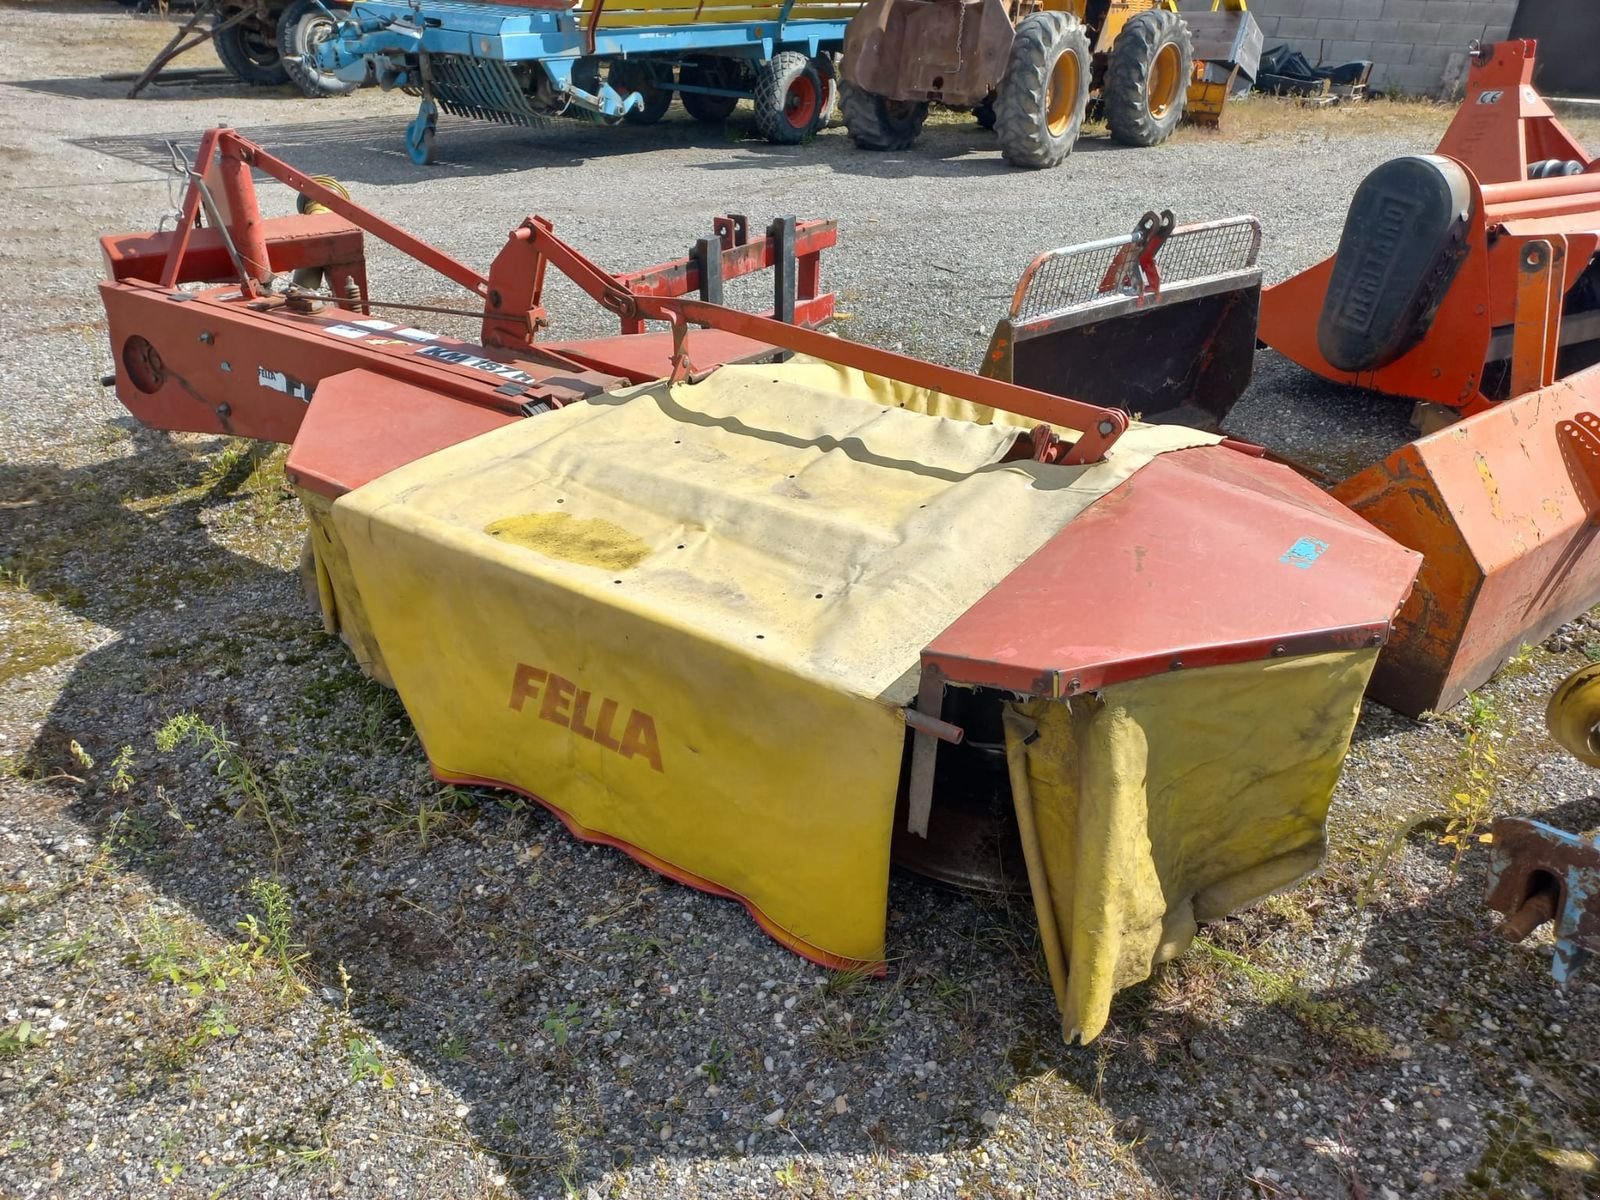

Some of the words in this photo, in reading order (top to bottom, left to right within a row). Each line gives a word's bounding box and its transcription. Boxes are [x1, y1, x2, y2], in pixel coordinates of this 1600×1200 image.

[423, 346, 471, 362] KM
[470, 359, 519, 375] 187
[508, 662, 665, 774] FELLA
